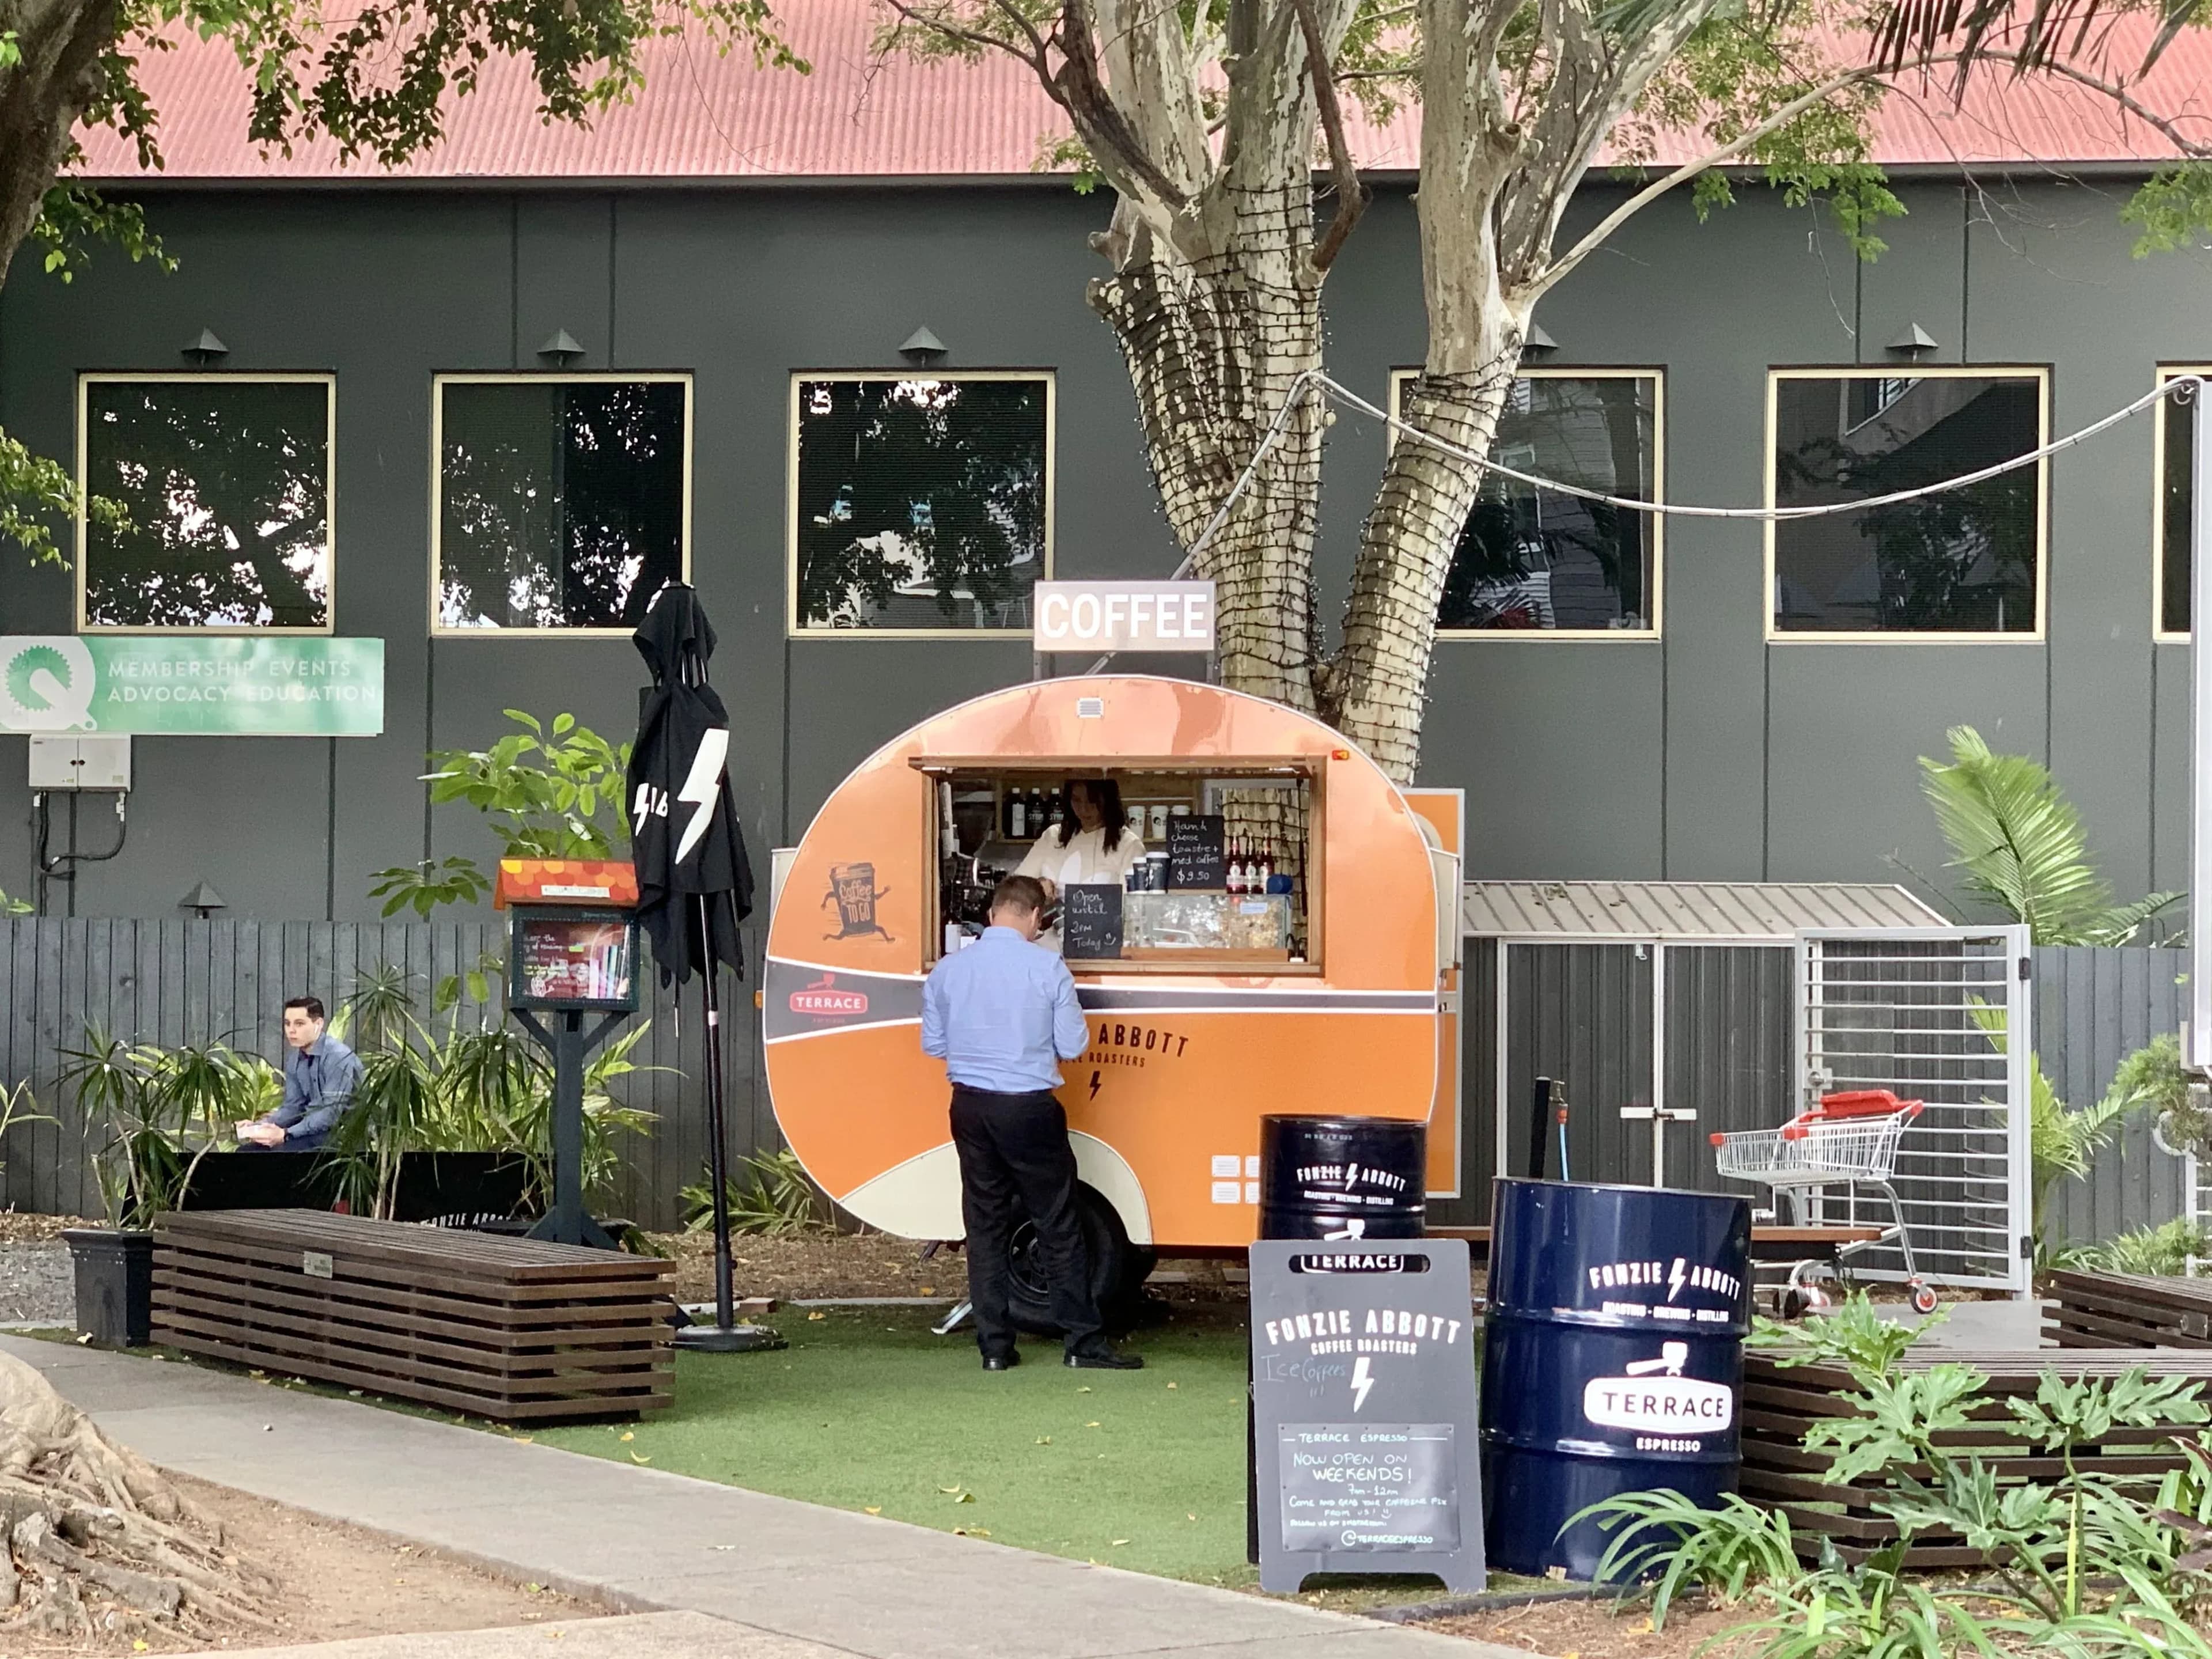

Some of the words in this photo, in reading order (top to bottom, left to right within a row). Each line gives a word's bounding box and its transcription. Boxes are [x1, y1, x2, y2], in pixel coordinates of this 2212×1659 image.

[1041, 593, 1207, 638] COFFEE
[108, 661, 253, 677] MEMBERSHIP
[270, 660, 351, 676] EVENTS
[108, 686, 228, 702] ADVOCACY
[247, 685, 376, 702] EDUCATION
[1173, 820, 1198, 832] Ham
[839, 880, 872, 904] Coffee
[1073, 889, 1102, 906] Open
[847, 904, 858, 923] TO
[859, 902, 871, 922] GO
[1072, 937, 1101, 950] Today
[796, 997, 861, 1009] TERRACE
[1099, 1023, 1189, 1057] ABBOTT
[1089, 1052, 1146, 1067] ROASTERS
[1297, 1165, 1342, 1182] FONZIE
[1362, 1168, 1406, 1192] ABBOTT
[1589, 1262, 1662, 1289] FONZIE
[1690, 1266, 1741, 1301] ABBOTT
[1266, 1310, 1351, 1346] FONZIE
[1366, 1309, 1461, 1344] ABBOTT
[1311, 1340, 1353, 1355] COFFEE
[1358, 1339, 1418, 1355] ROASTERS
[1602, 1392, 1724, 1418] TERRACE
[1298, 1433, 1350, 1442] TERRACE
[1360, 1433, 1408, 1442] ESPRESSO
[1636, 1437, 1700, 1452] ESPRESSO
[1294, 1452, 1327, 1467] NOW
[1332, 1452, 1374, 1465] OPEN
[1384, 1453, 1407, 1464] ON
